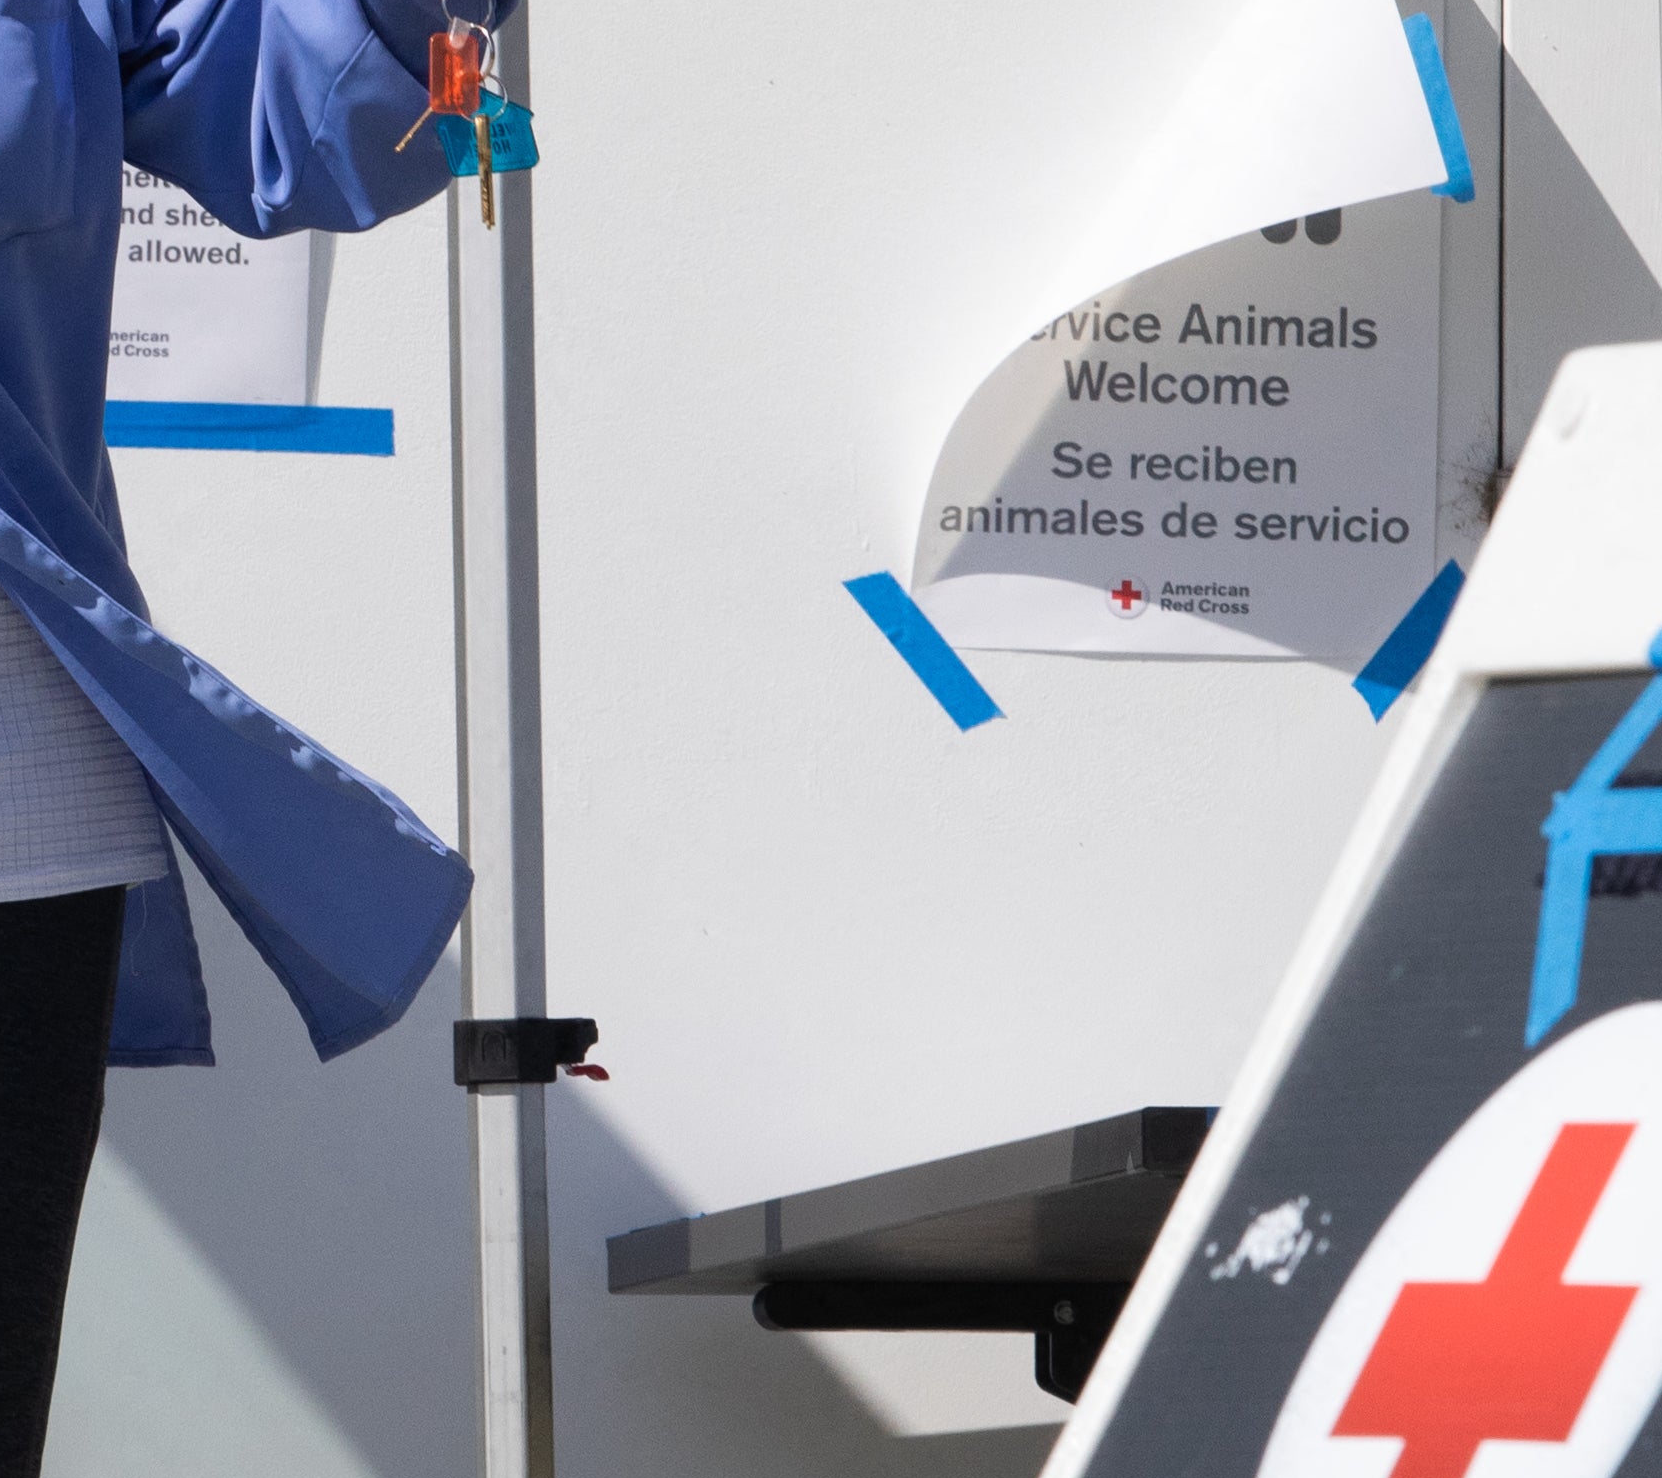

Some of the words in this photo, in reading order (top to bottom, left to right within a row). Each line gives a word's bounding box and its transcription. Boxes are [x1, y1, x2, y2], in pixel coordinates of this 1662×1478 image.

[128, 240, 250, 266] allowed.
[1178, 303, 1378, 350] Animals
[125, 344, 170, 358] Cross
[1063, 360, 1290, 407] Welcome
[1051, 441, 1112, 482] Se
[1129, 443, 1298, 484] reciben
[939, 498, 1144, 538] animales
[1160, 501, 1218, 540] de
[1233, 507, 1410, 545] servicio
[1160, 581, 1251, 598] American
[1160, 598, 1194, 614] Red
[1198, 598, 1251, 615] Cross
